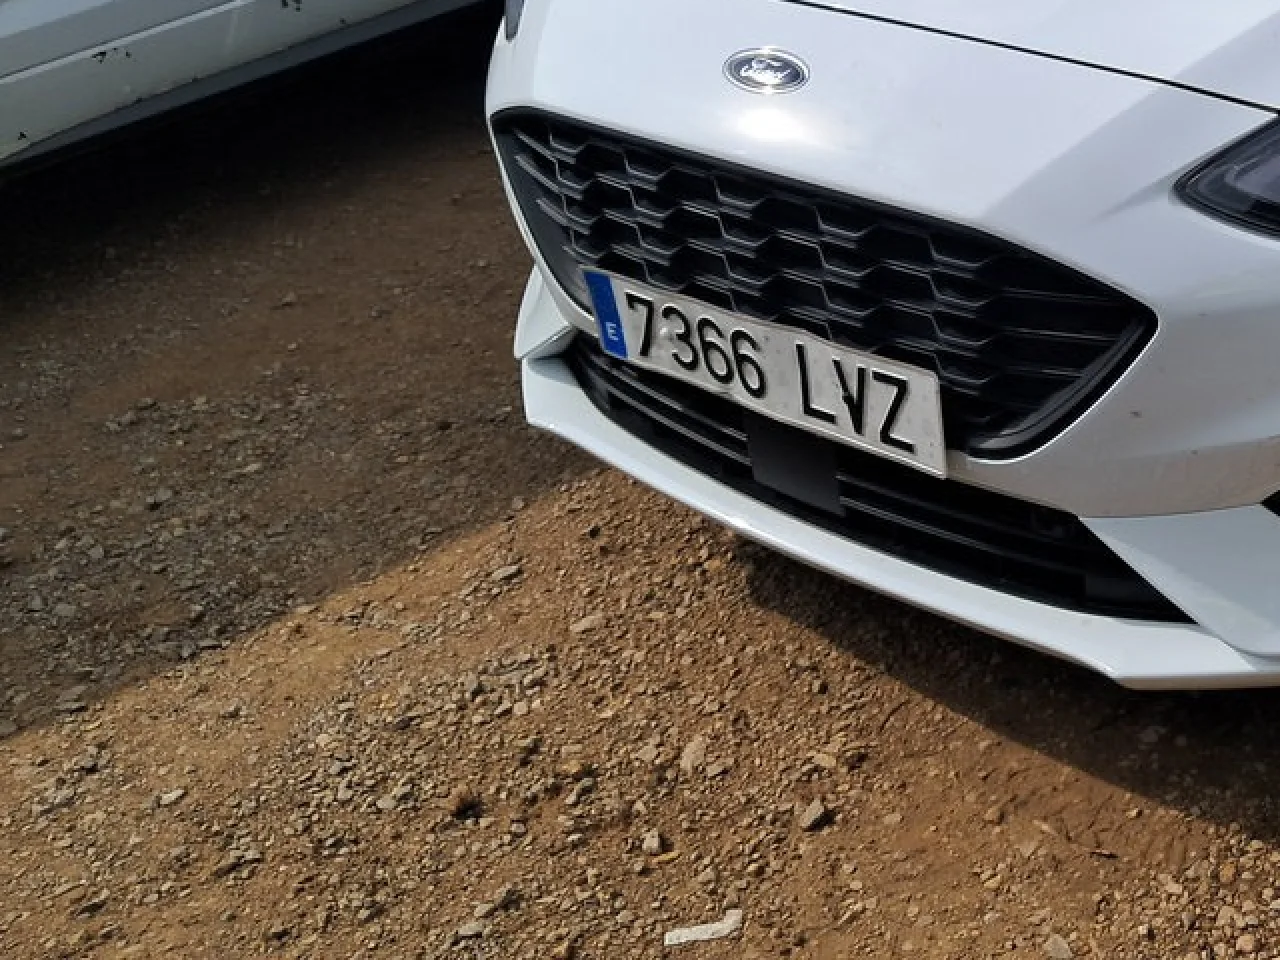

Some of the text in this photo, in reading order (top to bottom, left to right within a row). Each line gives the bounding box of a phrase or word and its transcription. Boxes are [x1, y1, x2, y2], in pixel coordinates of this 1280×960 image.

[605, 321, 619, 341] E
[625, 291, 917, 455] 7366 LVZ
